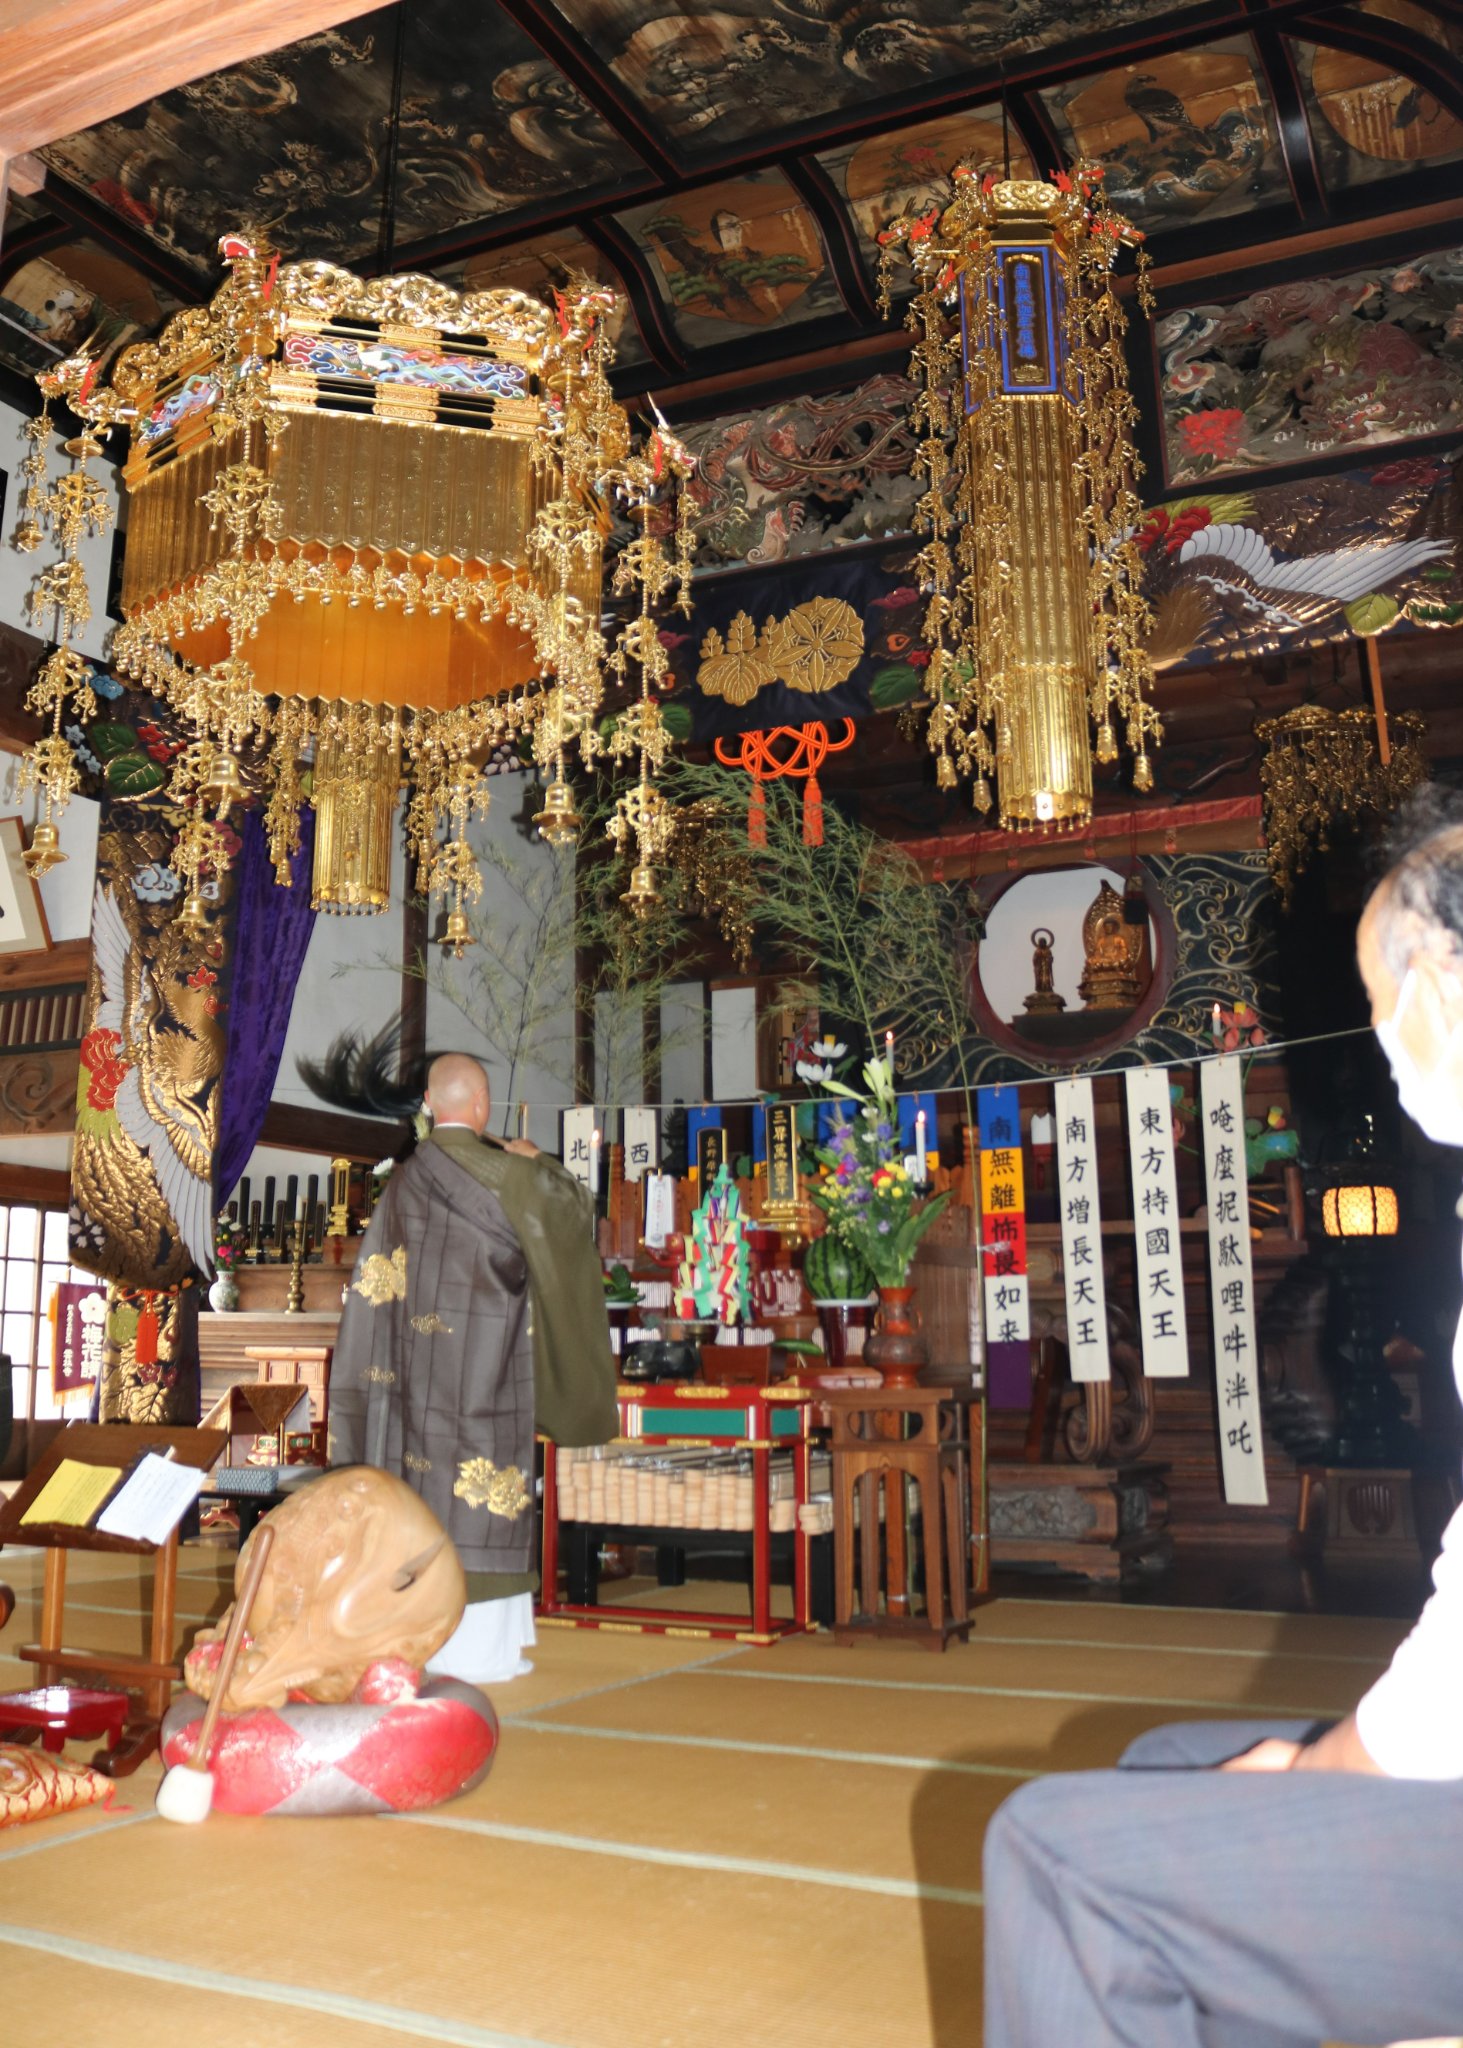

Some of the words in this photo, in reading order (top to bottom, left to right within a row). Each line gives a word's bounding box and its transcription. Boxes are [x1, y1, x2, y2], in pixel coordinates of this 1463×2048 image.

[1062, 1117, 1099, 1345] 南方増長天王
[1140, 1107, 1178, 1339] 東方持國天王
